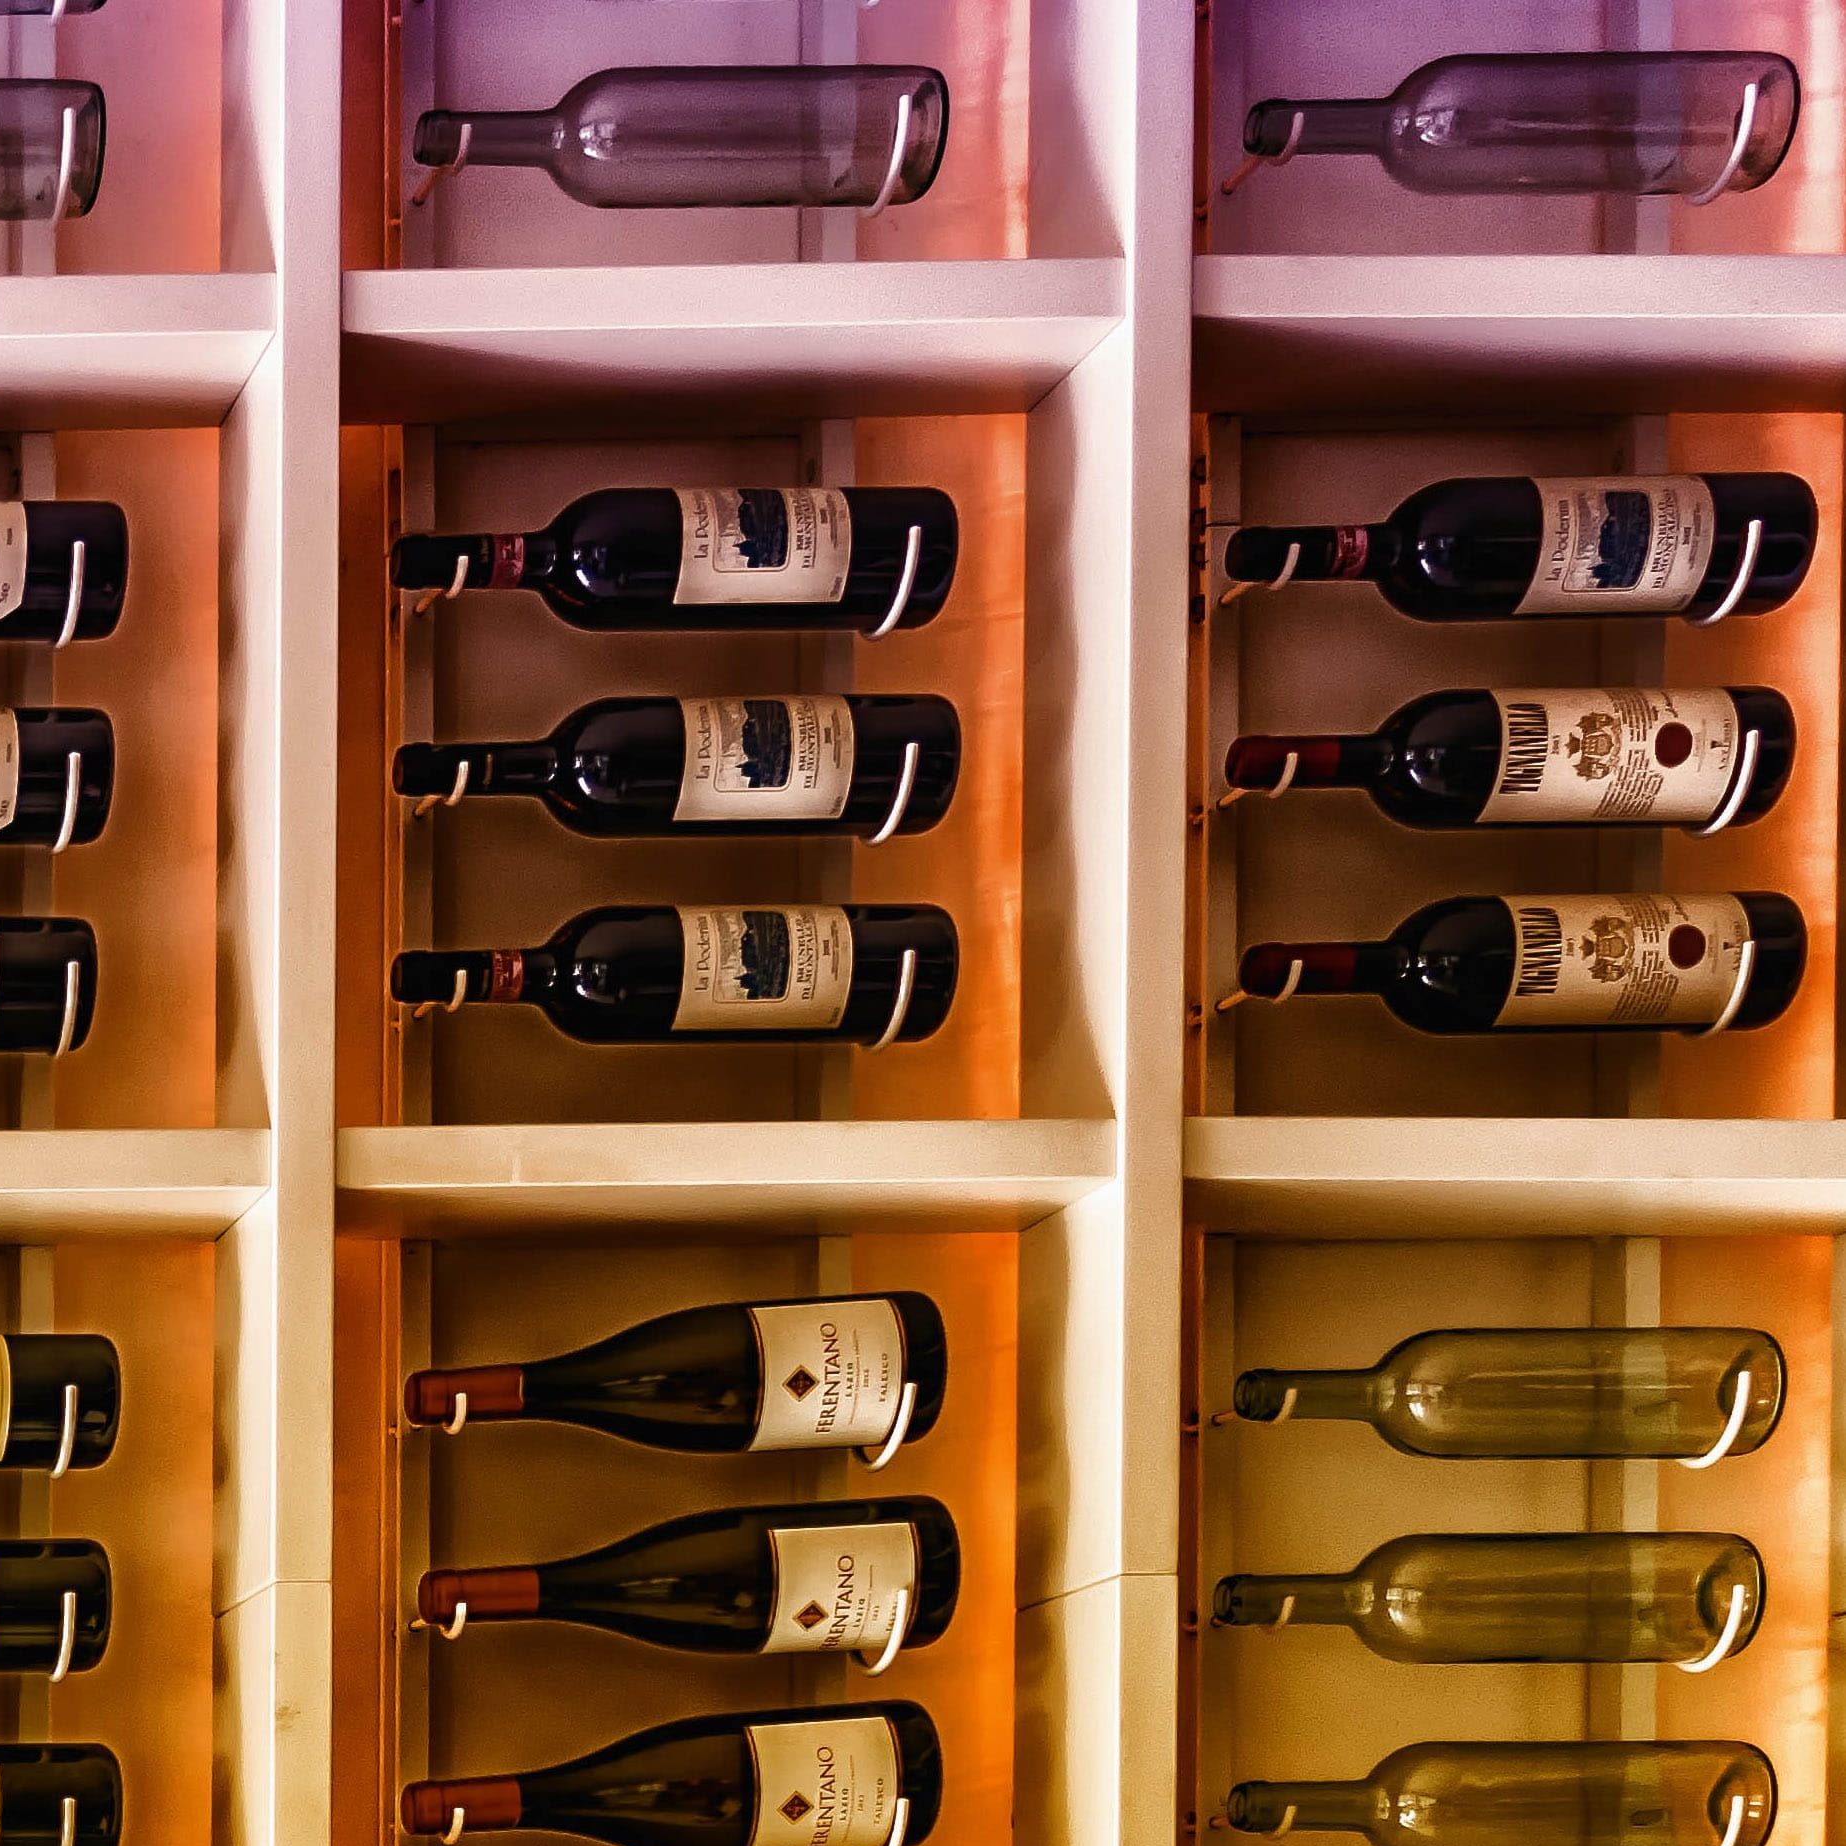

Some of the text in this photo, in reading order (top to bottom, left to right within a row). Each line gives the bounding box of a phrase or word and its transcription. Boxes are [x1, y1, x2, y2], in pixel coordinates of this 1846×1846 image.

[694, 544, 709, 559] La
[1545, 500, 1570, 581] La Poderina
[1652, 575, 1664, 589] DI
[1498, 703, 1548, 794] TIGNANELLO
[696, 765, 709, 779] La
[805, 775, 813, 788] DI
[1515, 908, 1562, 997] TIGNANELLO
[695, 976, 709, 990] La
[801, 986, 811, 999] DI
[816, 1324, 840, 1433] FERENTANO
[879, 1353, 888, 1402] FALESCO
[854, 1598, 865, 1627] LAZIO
[840, 1788, 849, 1821] LAZIO
[873, 1778, 883, 1825] FALESCO
